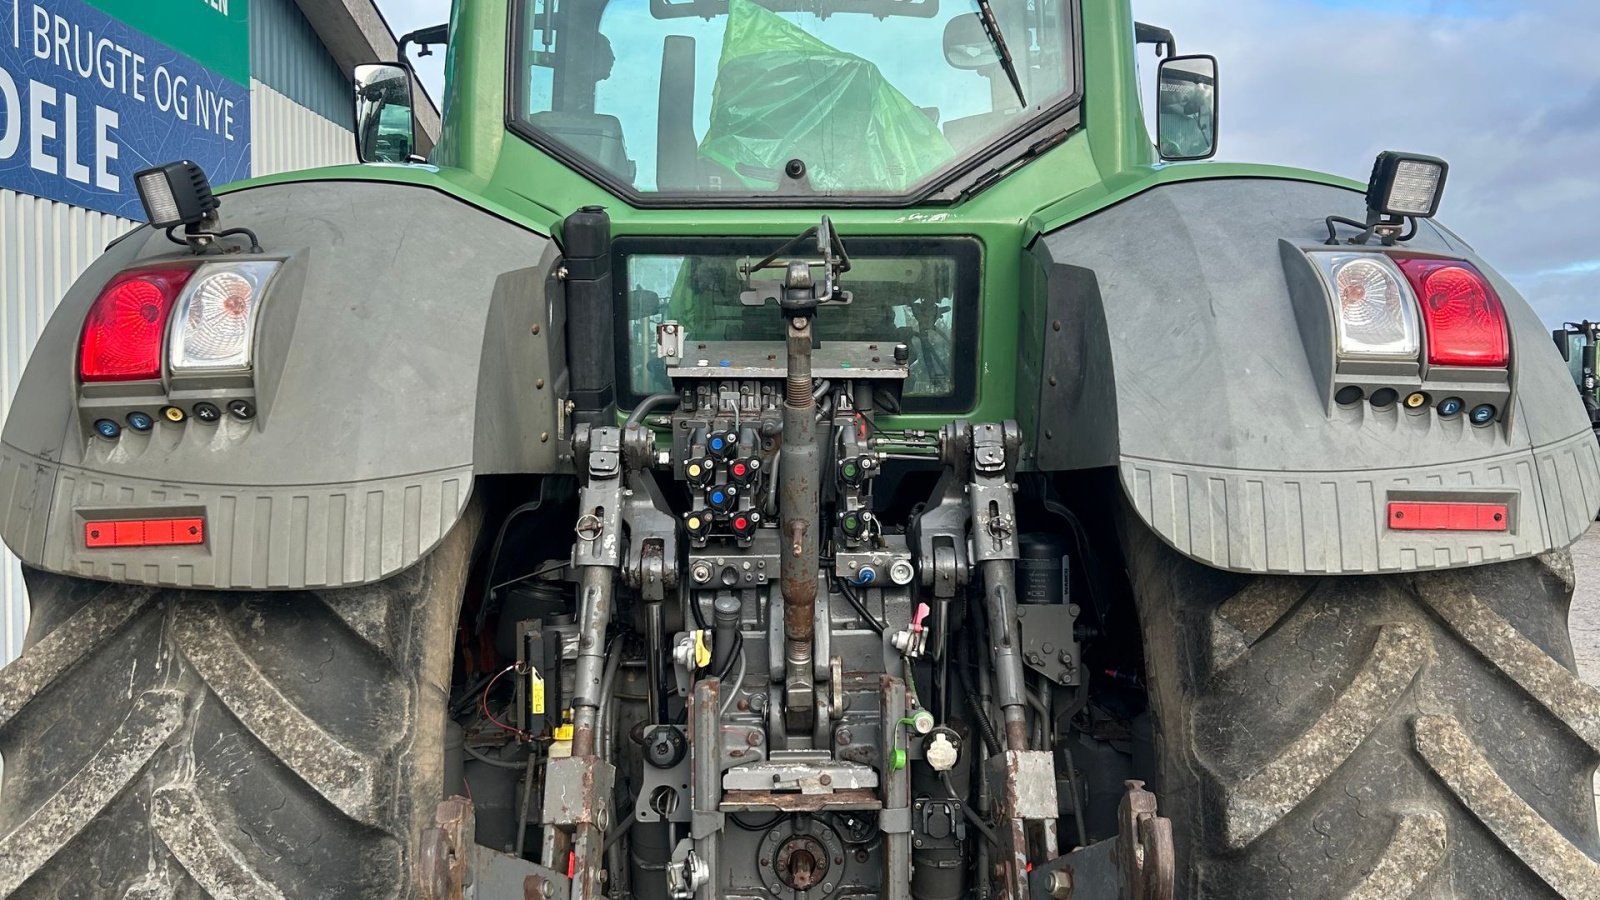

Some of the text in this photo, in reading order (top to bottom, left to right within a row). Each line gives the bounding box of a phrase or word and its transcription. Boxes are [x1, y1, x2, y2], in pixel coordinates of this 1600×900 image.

[33, 3, 146, 102] BRUGTE
[154, 65, 188, 121] OG
[196, 84, 234, 141] NYE
